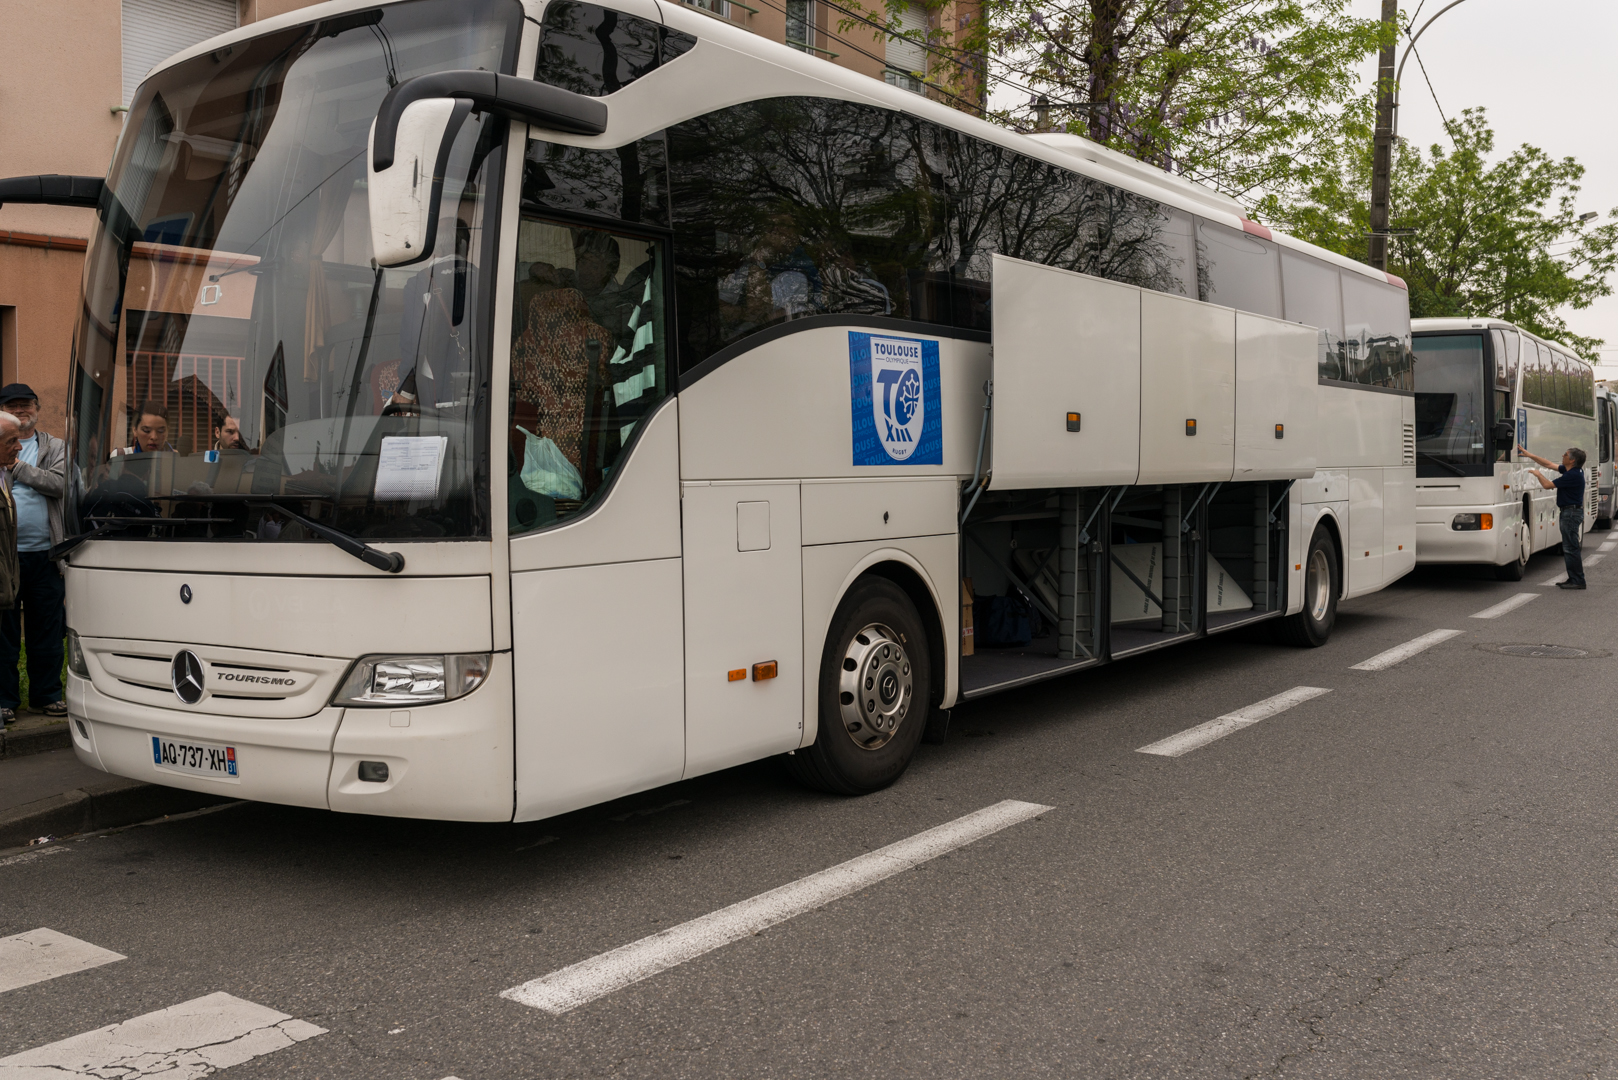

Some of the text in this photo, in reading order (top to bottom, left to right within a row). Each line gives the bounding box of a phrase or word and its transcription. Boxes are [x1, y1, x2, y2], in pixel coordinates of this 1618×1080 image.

[874, 343, 919, 358] TOULOUSE
[885, 356, 909, 364] OLYMPIQUE
[885, 418, 914, 442] XIII
[892, 447, 907, 456] RUGBY
[217, 672, 297, 686] TOURISMO
[162, 742, 227, 772] AQ-737-XH
[228, 761, 237, 774] 31
